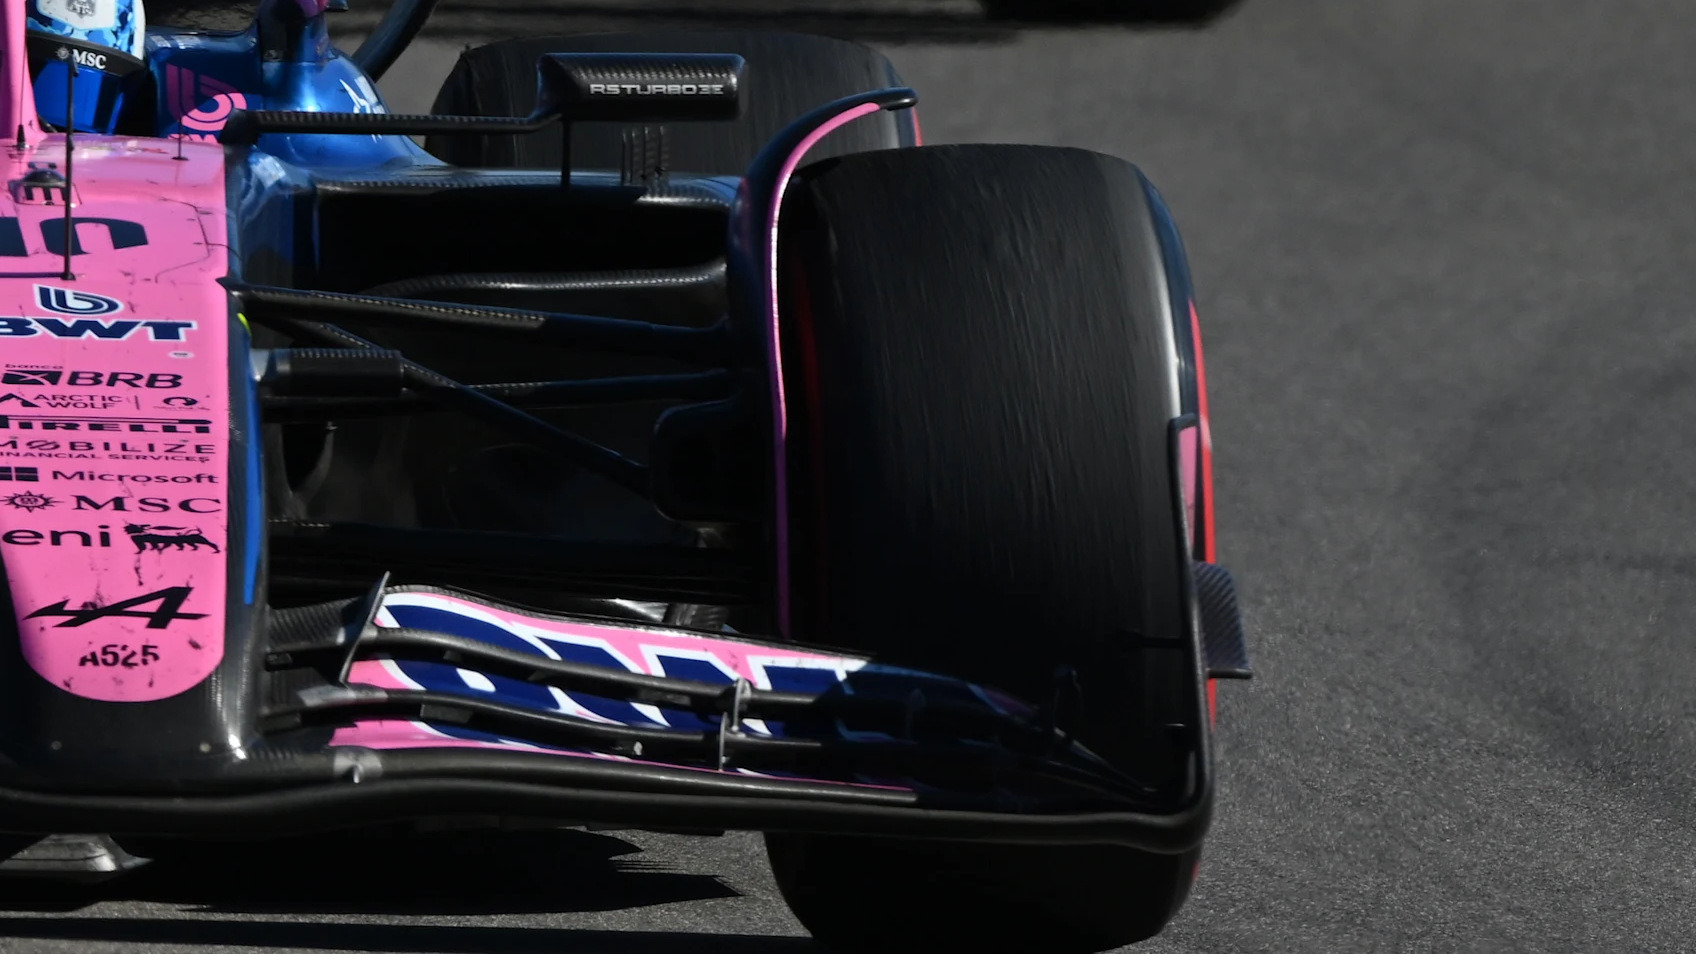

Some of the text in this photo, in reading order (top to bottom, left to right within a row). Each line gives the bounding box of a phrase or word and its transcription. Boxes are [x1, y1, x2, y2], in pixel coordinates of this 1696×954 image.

[72, 48, 107, 70] MSC
[66, 371, 183, 389] BRB
[34, 394, 122, 402] ARCTIC
[47, 401, 116, 409] WOLF
[108, 453, 210, 462] SERVICES
[52, 470, 219, 484] Microsoft
[72, 495, 222, 514] MSC
[1, 525, 112, 547] eni
[78, 644, 161, 667] A525
